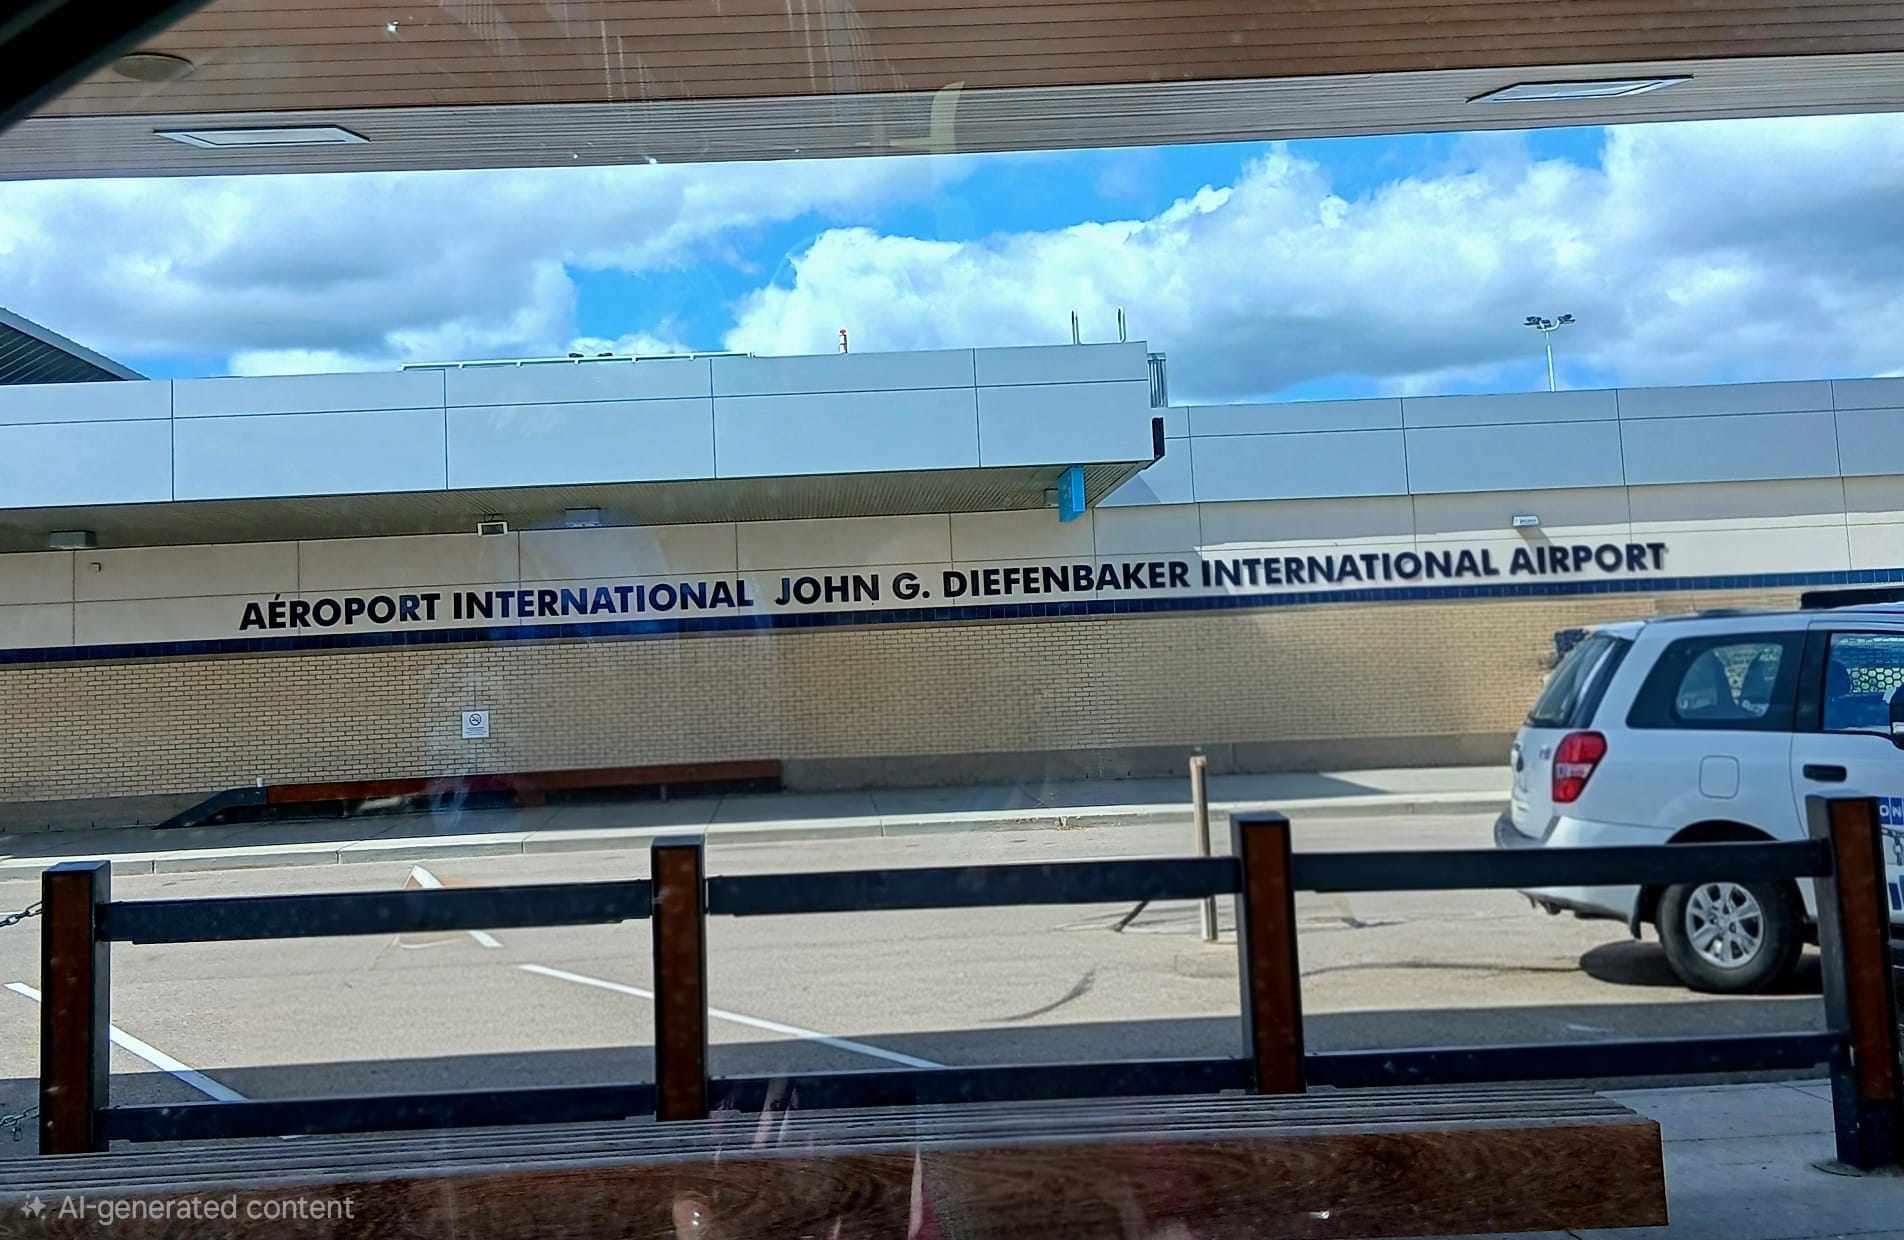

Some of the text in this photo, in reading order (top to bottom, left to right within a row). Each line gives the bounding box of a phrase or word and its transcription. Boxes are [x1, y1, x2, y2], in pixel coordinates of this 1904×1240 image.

[239, 543, 1667, 630] AÉROPORT INTERNATIONAL JOHN G. DIEFENBAKER INTERNATIONAL AIRPORT
